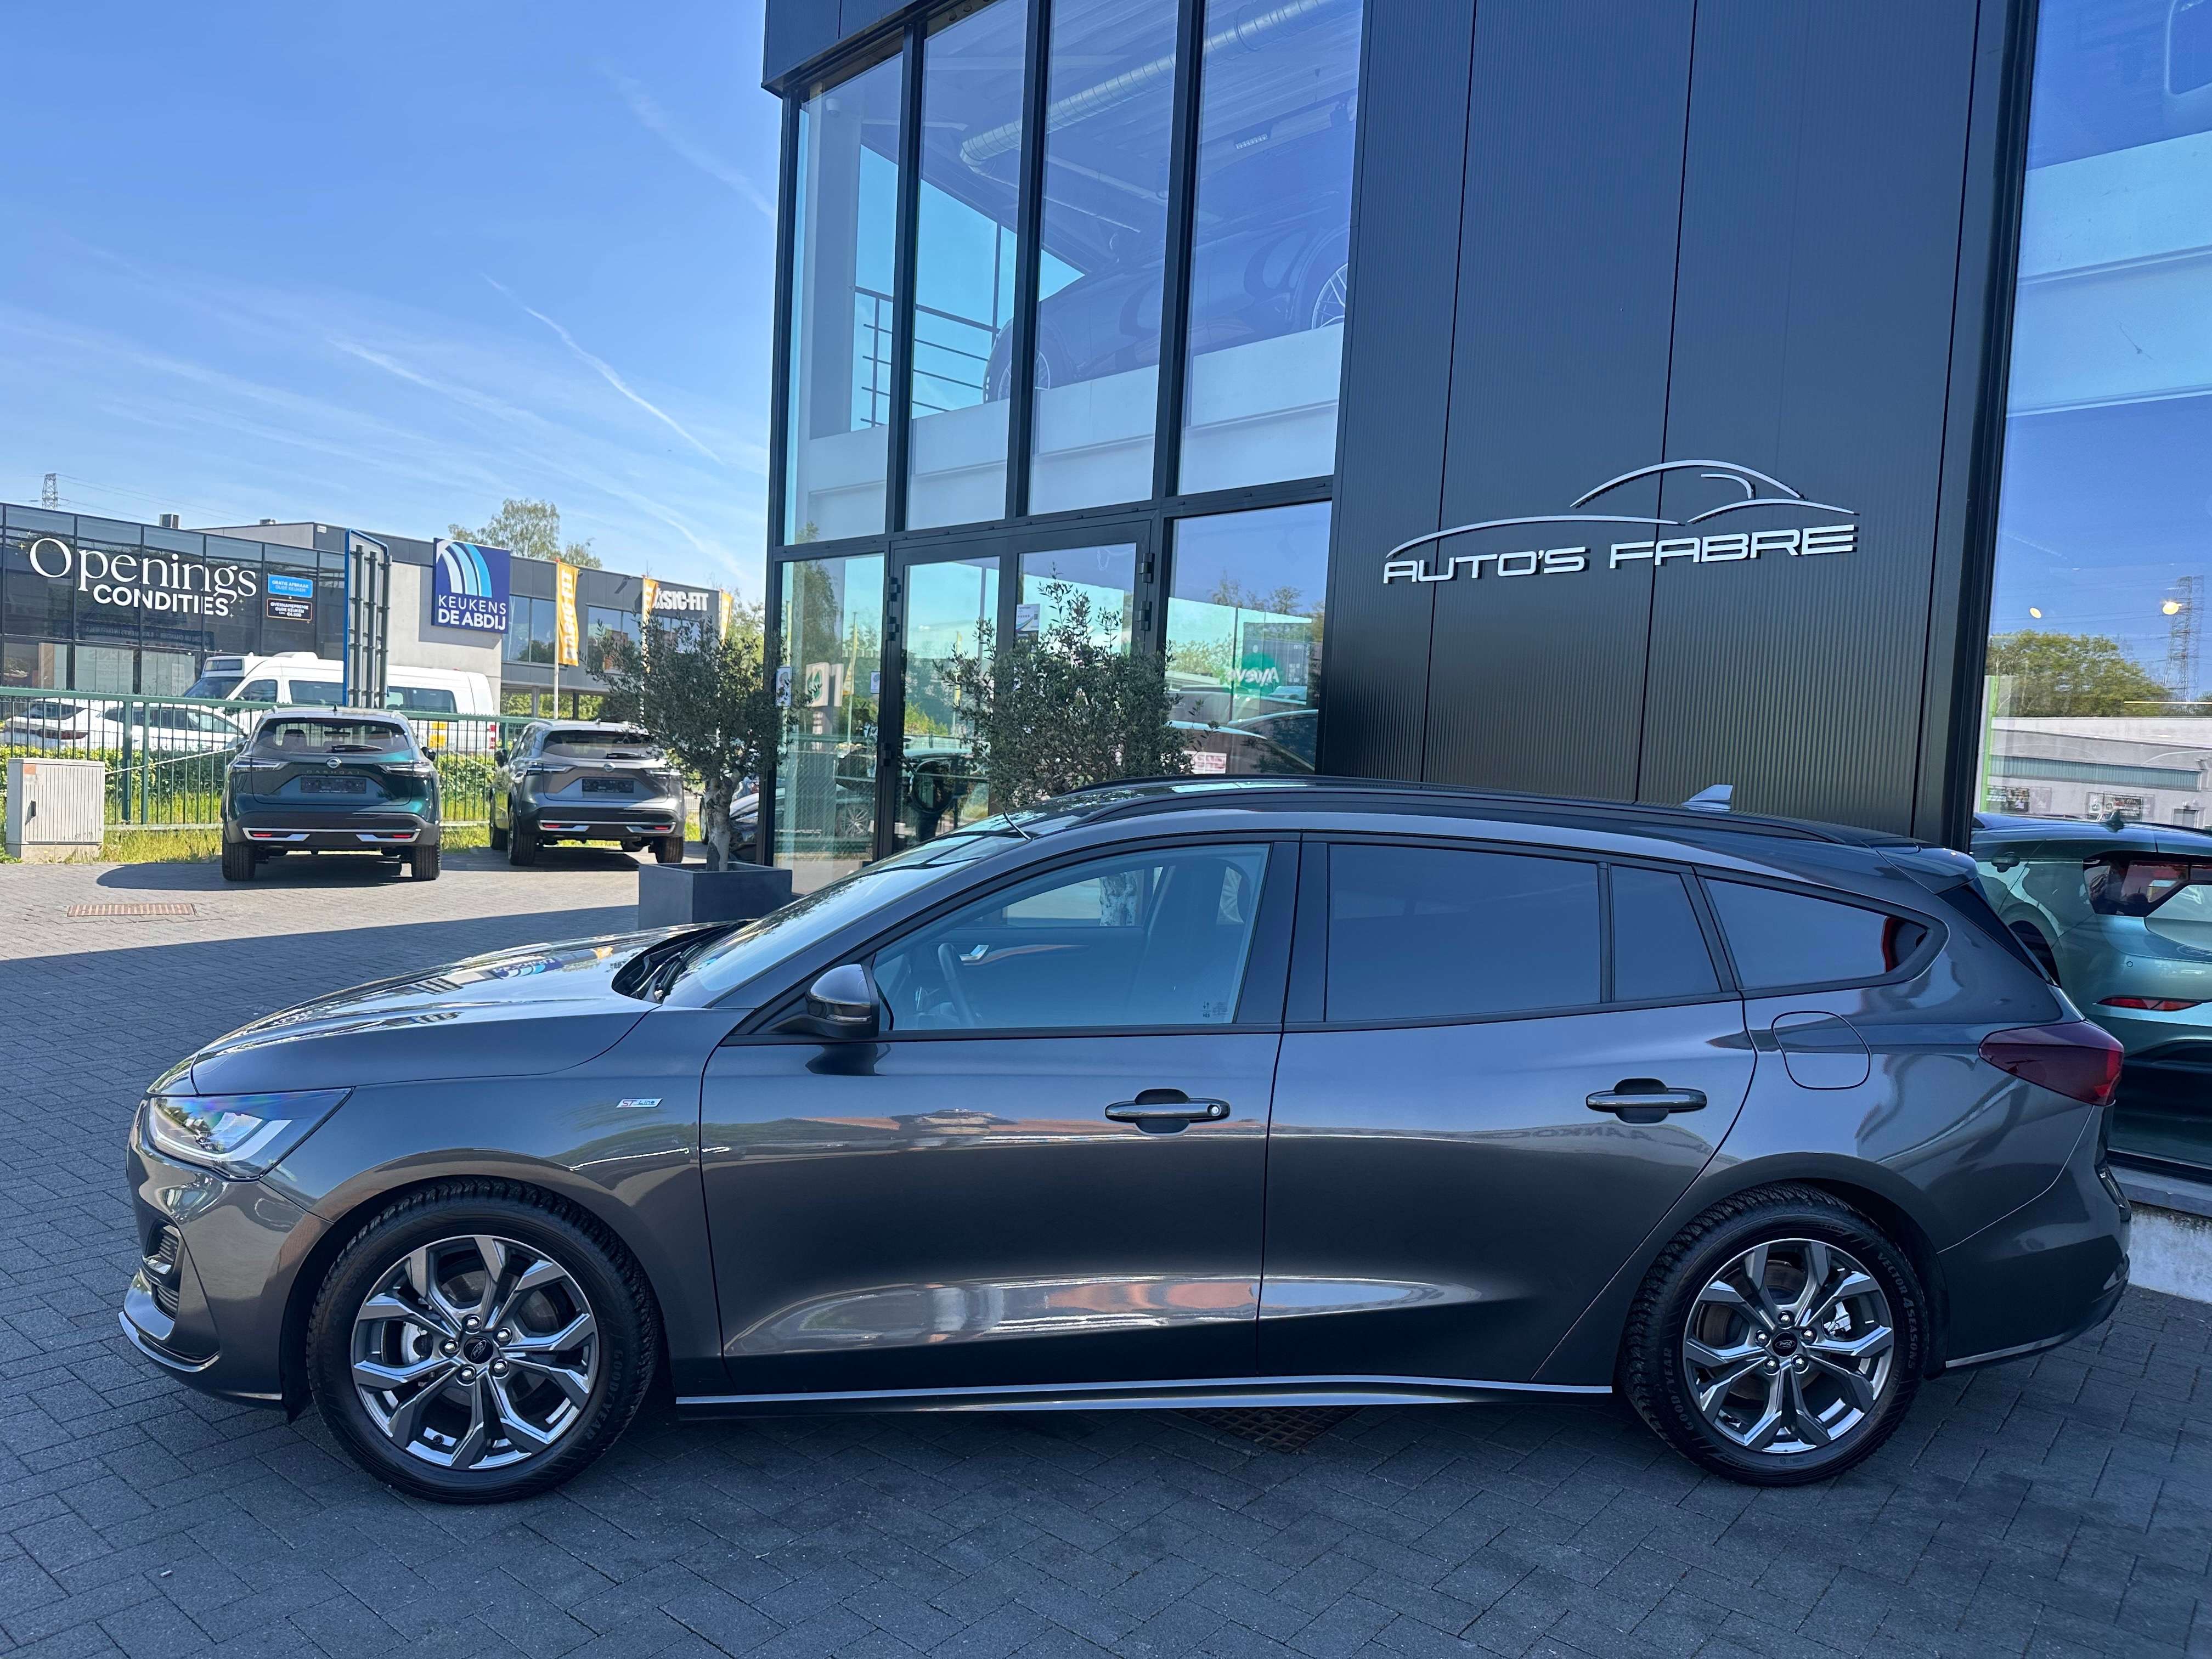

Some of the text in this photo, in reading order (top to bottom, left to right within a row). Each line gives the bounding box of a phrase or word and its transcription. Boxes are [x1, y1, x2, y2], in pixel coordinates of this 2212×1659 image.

[30, 538, 257, 603] Openings
[1383, 524, 1854, 584] AUTO'S FABRE
[93, 584, 229, 616] CONDITIES
[438, 594, 506, 615] KEUKENS
[438, 608, 506, 630] DE ABDIJ
[1877, 1252, 1908, 1294] VECTOR
[585, 1349, 623, 1440] GOODYEAR
